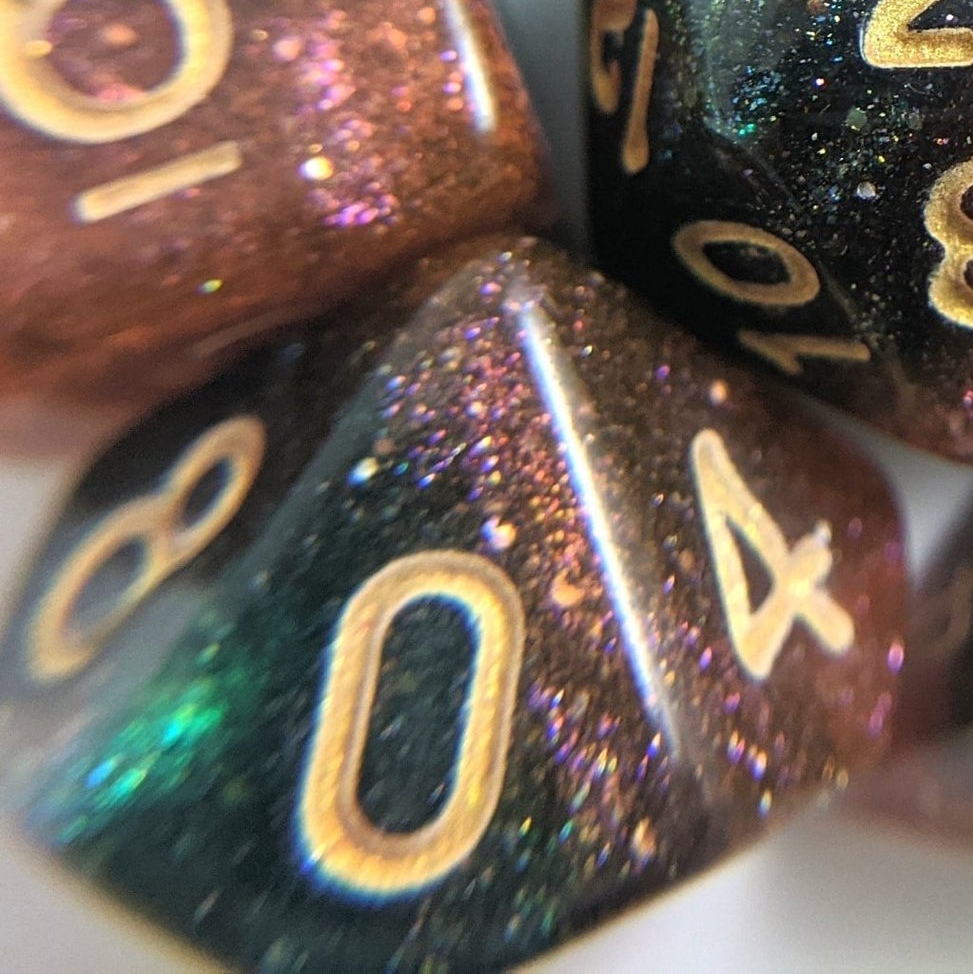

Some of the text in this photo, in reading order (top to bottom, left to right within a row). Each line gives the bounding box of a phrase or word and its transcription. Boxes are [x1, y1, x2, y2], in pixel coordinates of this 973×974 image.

[673, 219, 870, 376] 10
[25, 416, 266, 684] 8
[688, 429, 855, 681] 4
[298, 548, 524, 901] 0
